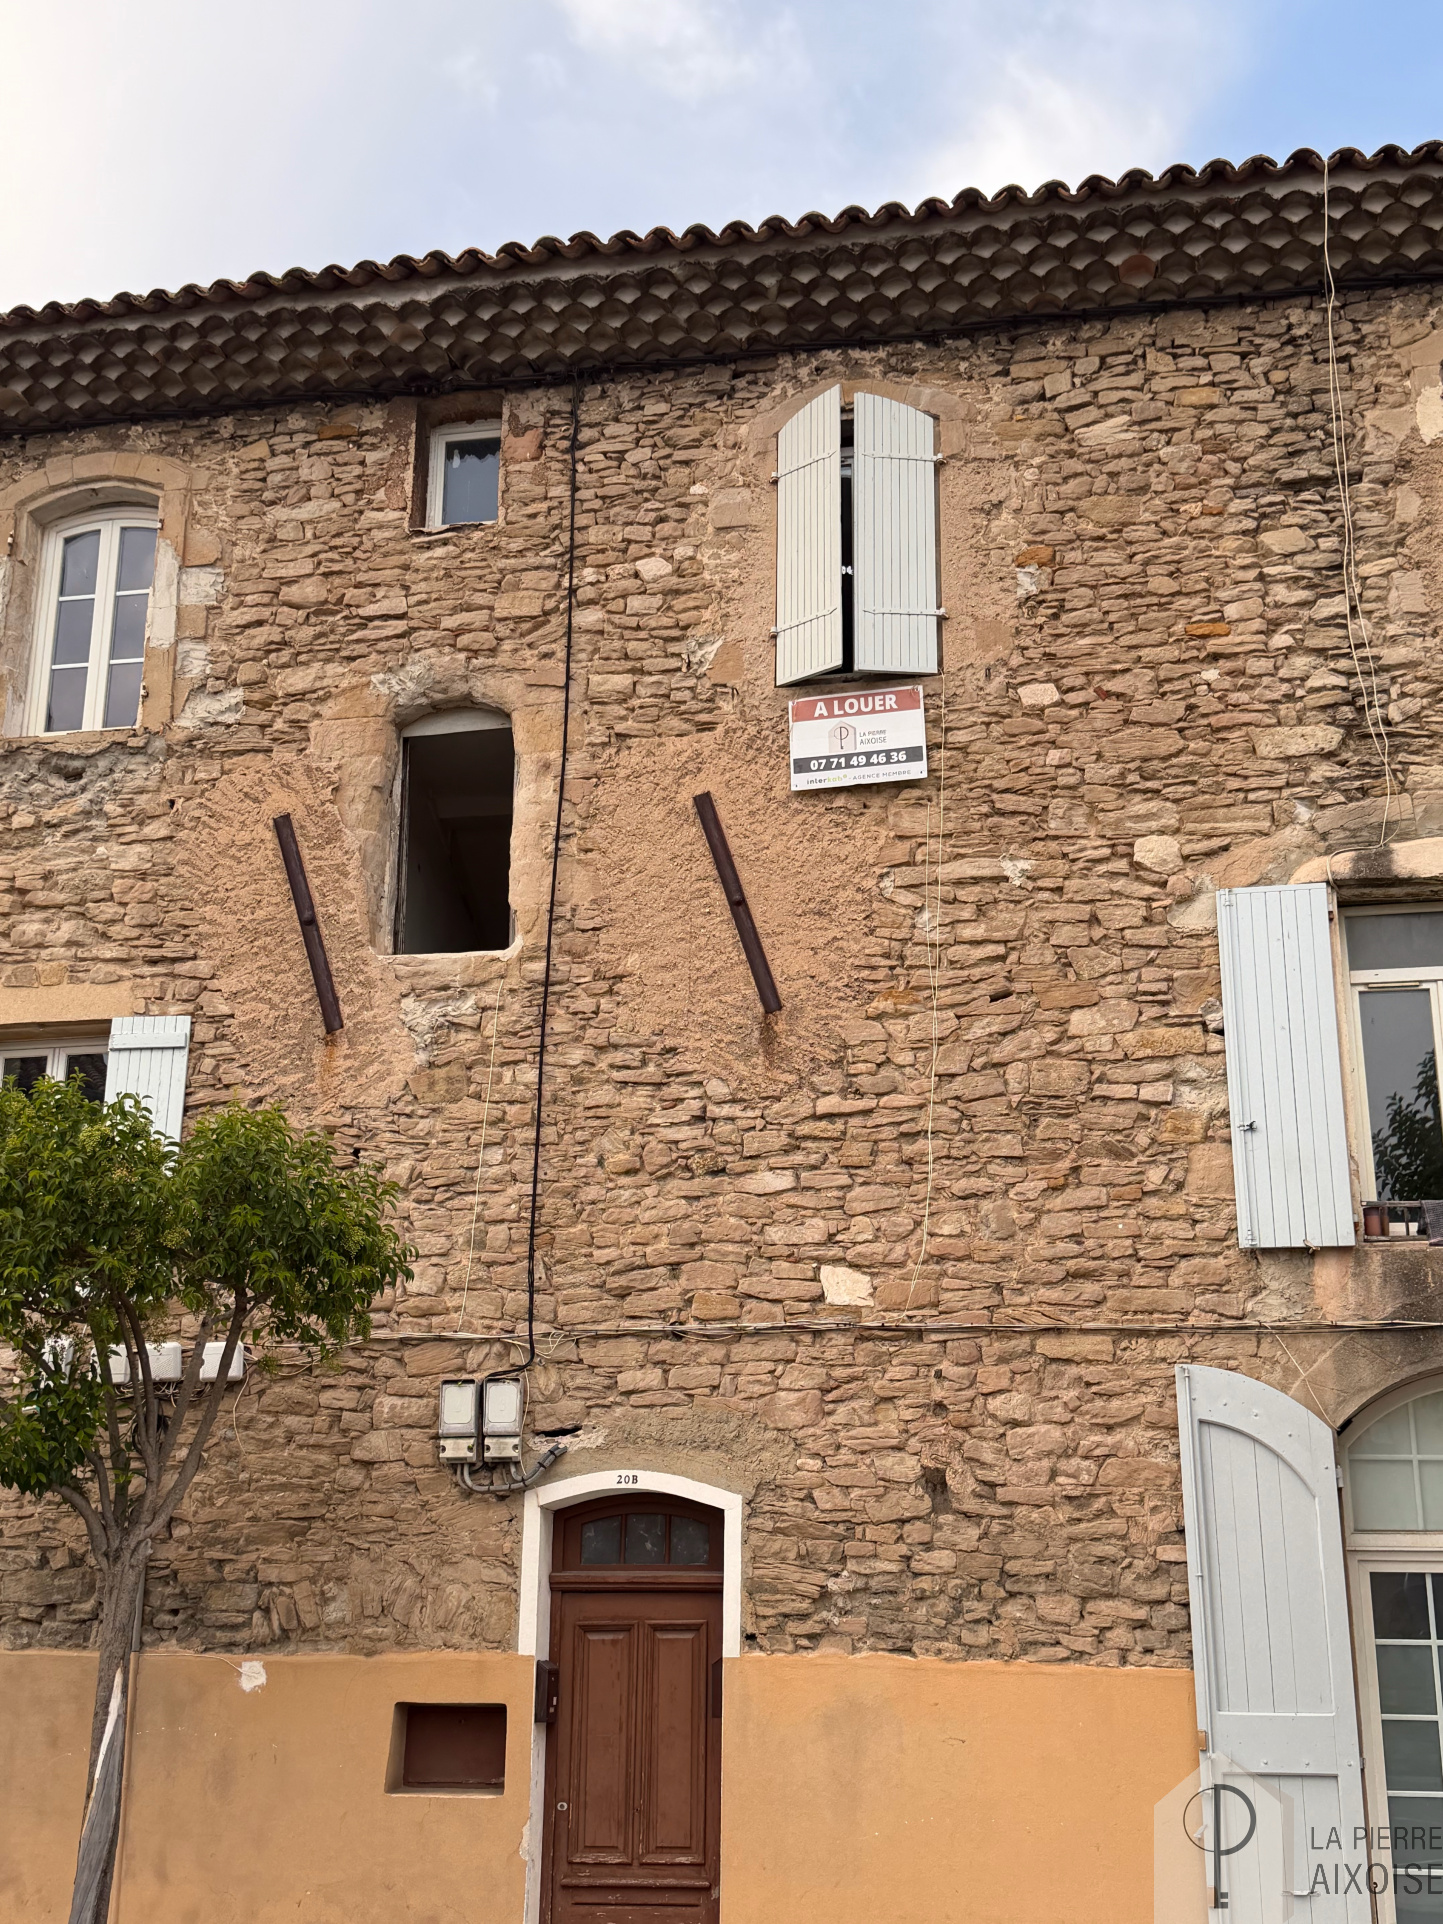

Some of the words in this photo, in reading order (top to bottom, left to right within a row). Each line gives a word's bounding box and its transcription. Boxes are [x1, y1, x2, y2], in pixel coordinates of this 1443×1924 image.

[814, 701, 829, 718] A
[833, 694, 899, 715] LOUER
[859, 736, 887, 745] AIXOISE
[810, 759, 826, 770] 07
[830, 757, 846, 769] 71
[850, 755, 866, 766] 49
[869, 753, 886, 764] 46
[890, 751, 907, 762] 36
[616, 1474, 639, 1485] 20B
